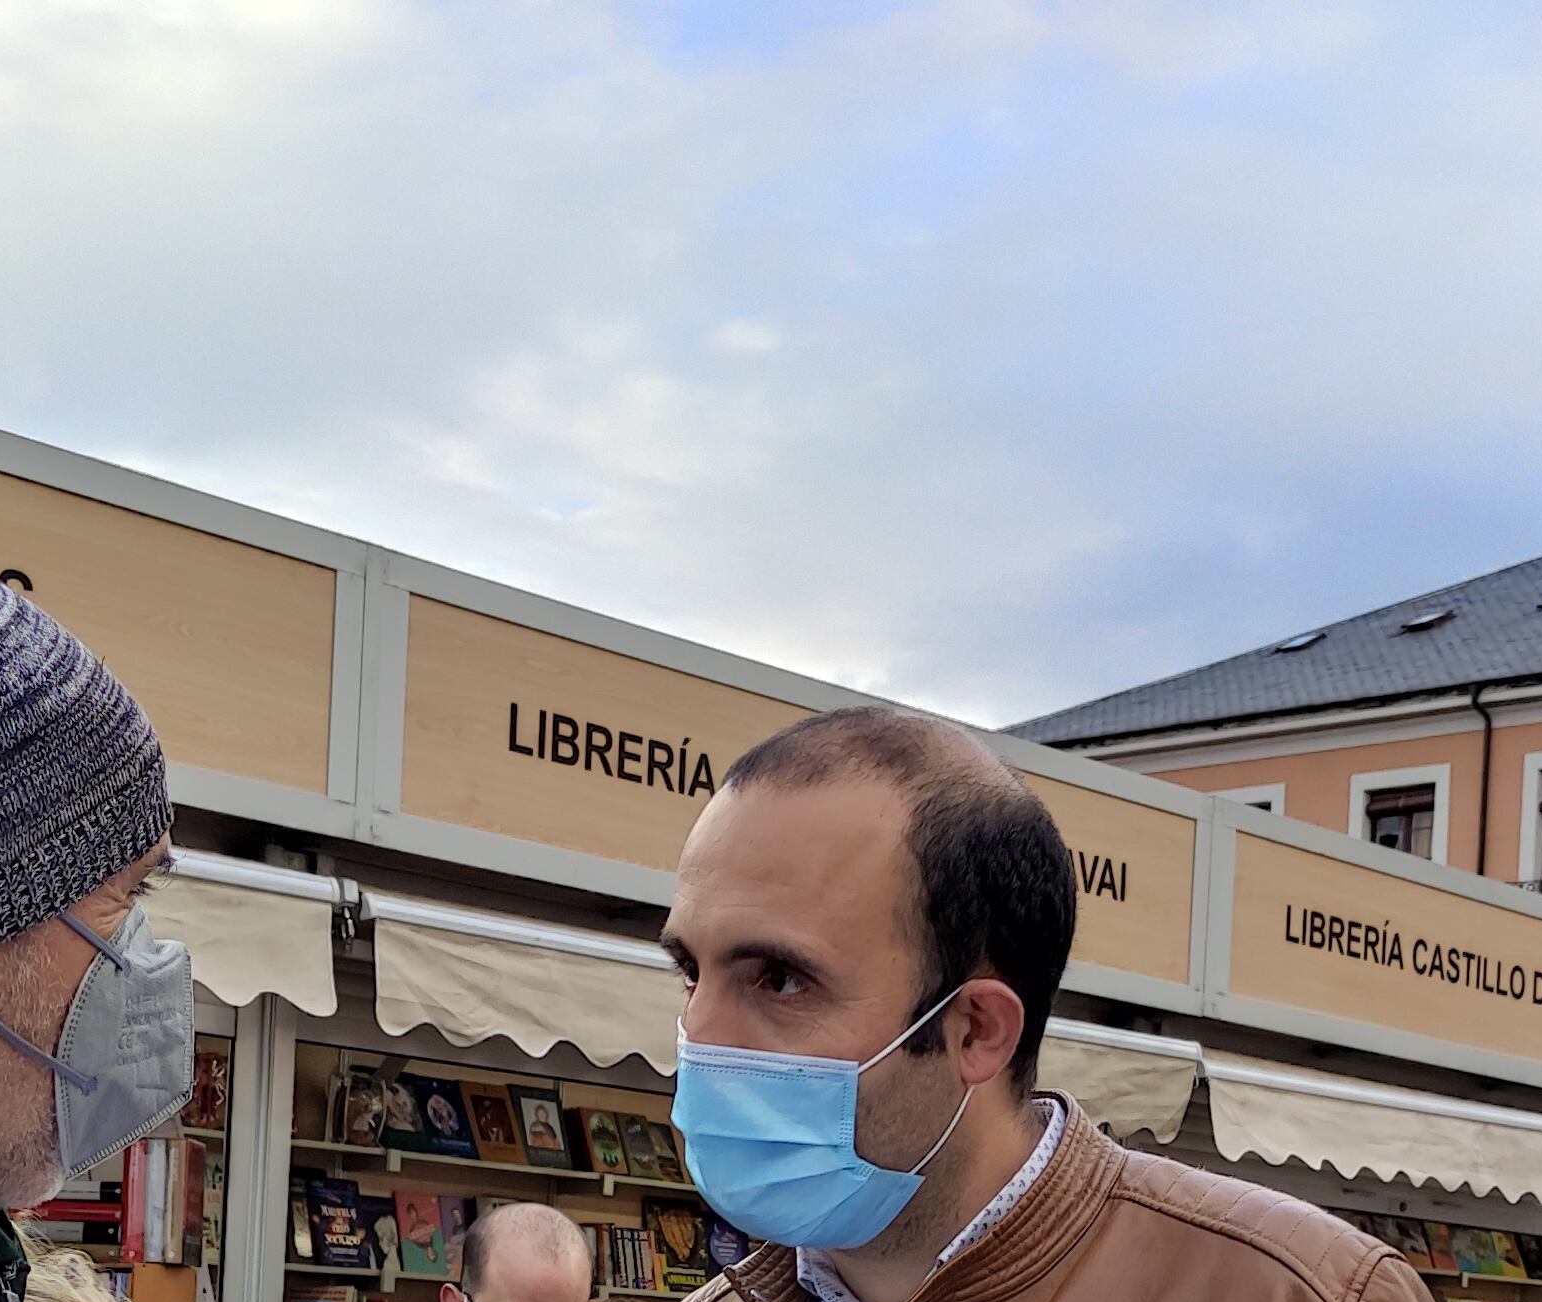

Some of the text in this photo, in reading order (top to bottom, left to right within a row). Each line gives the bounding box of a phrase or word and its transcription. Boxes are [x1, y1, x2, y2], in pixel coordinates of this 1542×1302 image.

[507, 702, 716, 798] LIBRERÍA
[1285, 904, 1404, 970] LIBRERÍA
[1412, 937, 1526, 1001] CASTILLO
